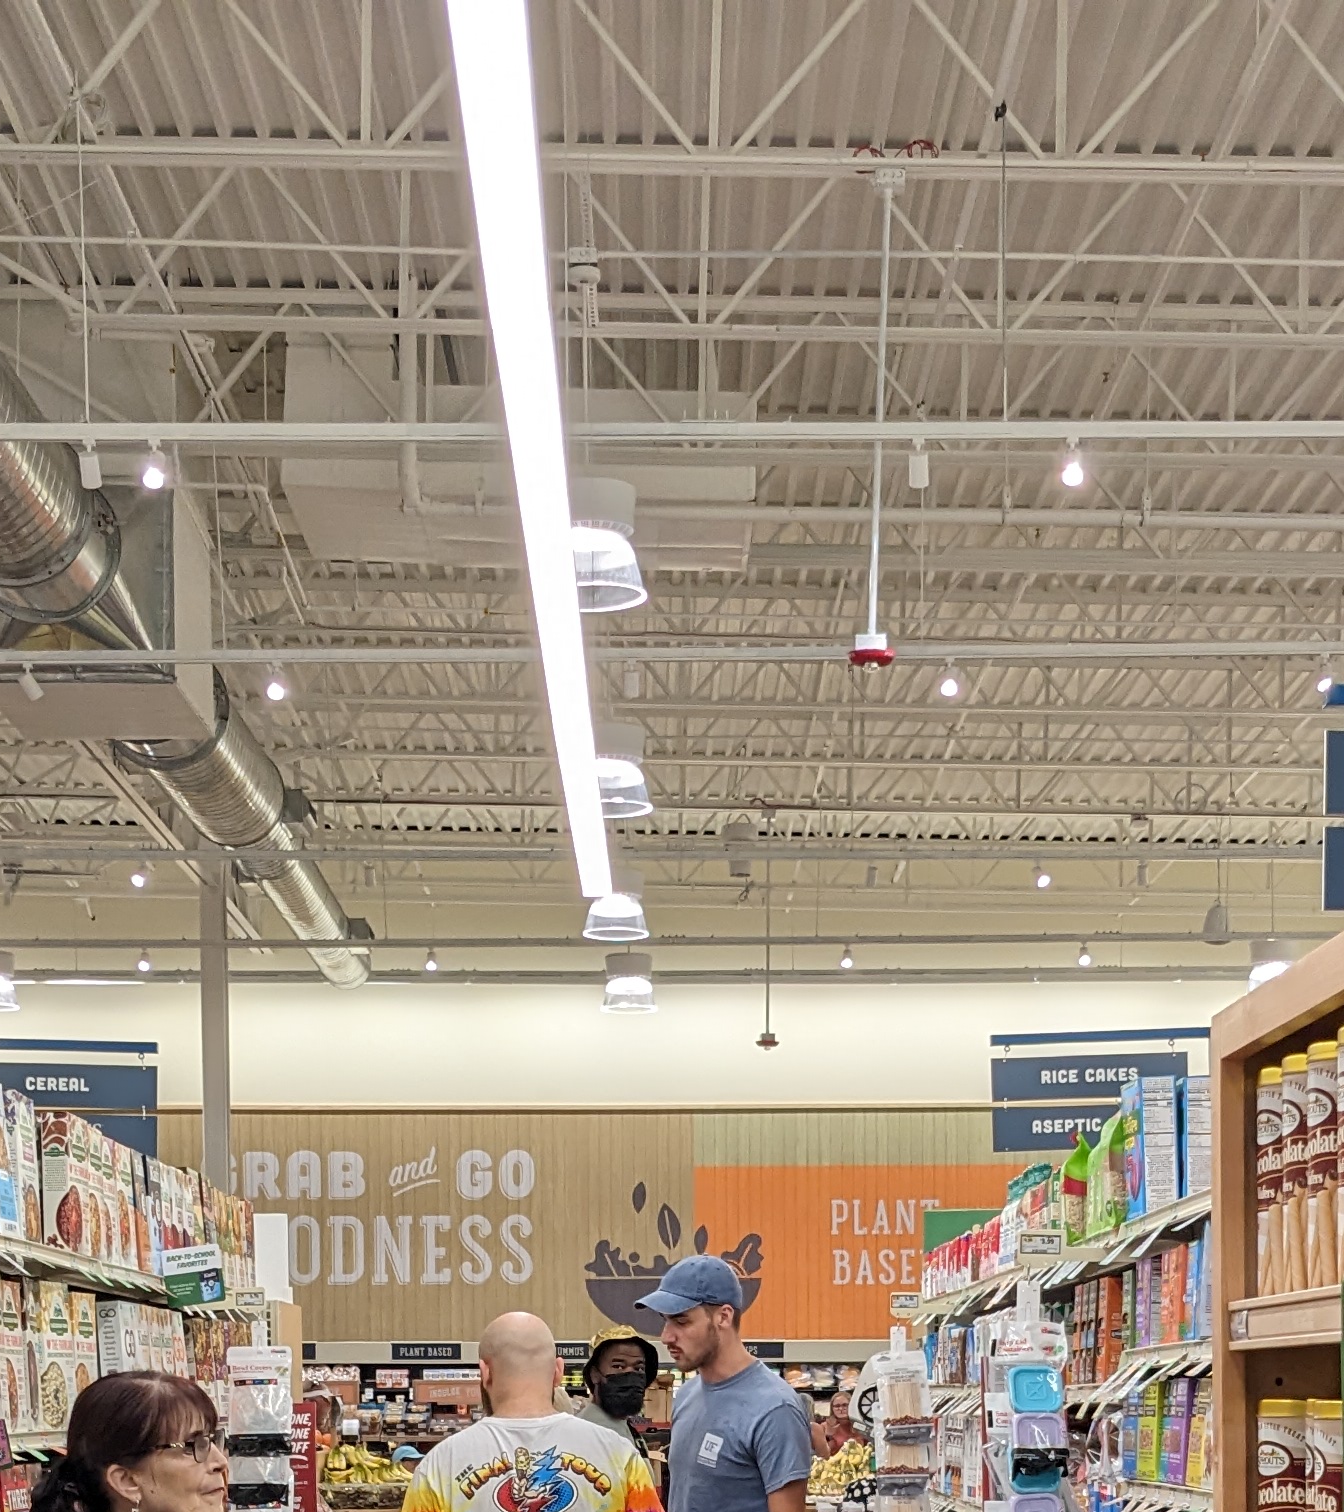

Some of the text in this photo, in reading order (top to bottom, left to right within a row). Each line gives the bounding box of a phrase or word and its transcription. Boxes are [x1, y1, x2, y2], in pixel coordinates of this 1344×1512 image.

[25, 1075, 90, 1093] CEREAL
[1041, 1067, 1138, 1085] RICE CAKES
[1032, 1118, 1102, 1134] ASEPTIC
[389, 1146, 440, 1193] and
[457, 1149, 536, 1200] GO
[288, 1214, 534, 1286] ODNESS
[832, 1248, 926, 1286] BASE
[399, 1346, 452, 1357] PLANT BASED
[557, 1346, 586, 1357] UMMUS
[455, 1464, 474, 1483] THE
[459, 1452, 612, 1500] FINAL TOUR
